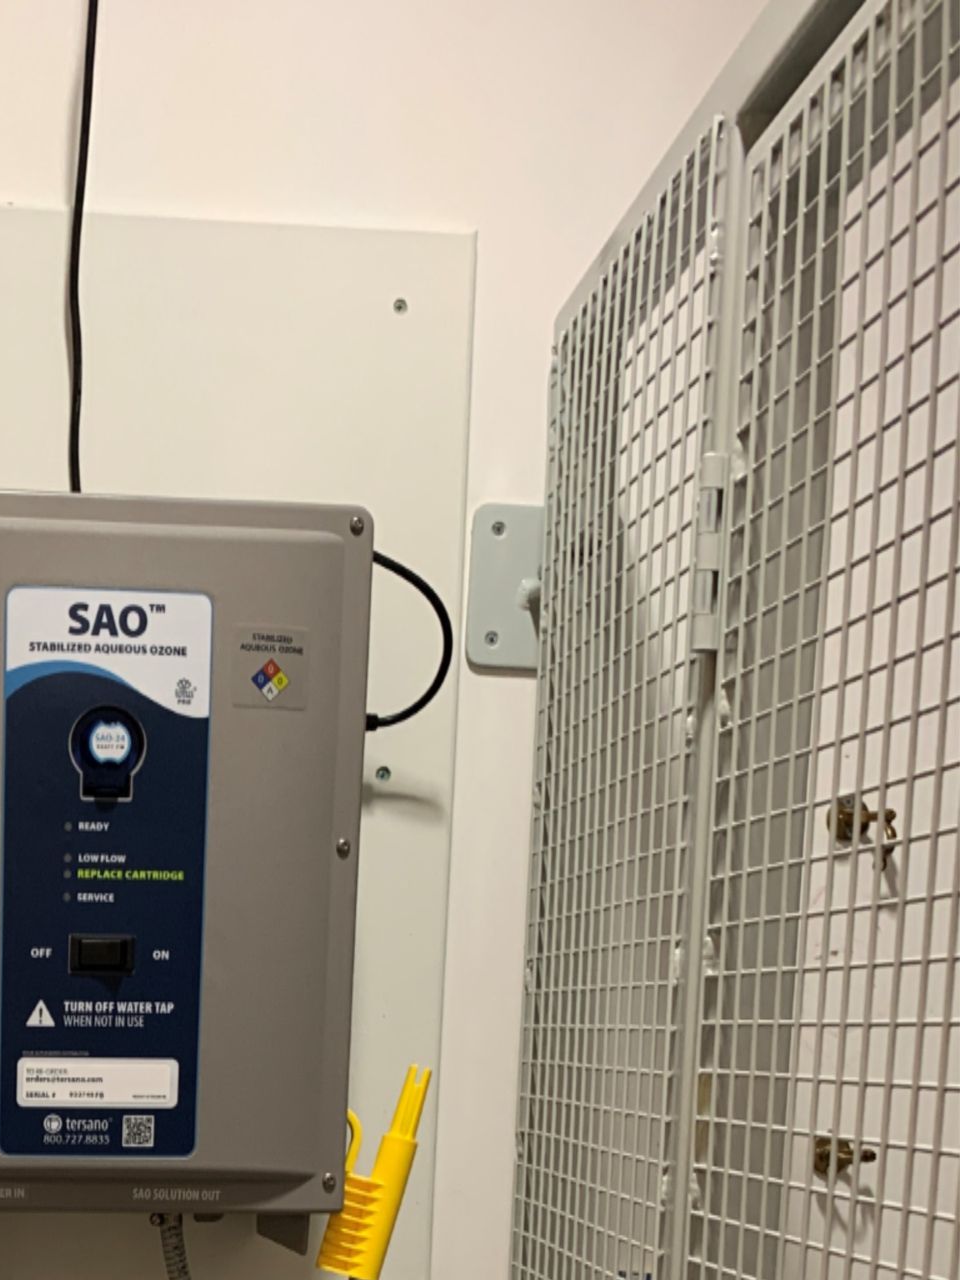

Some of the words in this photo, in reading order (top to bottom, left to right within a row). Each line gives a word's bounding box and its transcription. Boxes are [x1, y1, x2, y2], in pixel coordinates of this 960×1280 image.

[29, 642, 91, 652] STABILIZED
[95, 643, 147, 655] AQUEOUS
[150, 646, 187, 656] OZONE
[240, 643, 276, 652] AQUEOUS
[78, 822, 109, 832] READY
[78, 854, 99, 863] LOW
[100, 854, 126, 864] FLOW
[77, 869, 123, 880] REPLACE
[125, 870, 185, 881] CARTRIDGE
[77, 893, 115, 903] SERVICE
[30, 948, 52, 959] OFF
[152, 950, 170, 961] ON
[64, 1001, 93, 1013] TURN
[95, 1001, 115, 1013] OFF
[116, 1002, 153, 1014] WATER
[154, 1002, 175, 1014] TAP
[63, 1015, 93, 1027] WHEN
[94, 1015, 113, 1027] NOT
[115, 1015, 125, 1027] IN
[126, 1015, 144, 1027] USE
[26, 1076, 103, 1084] orders@tersano.com
[65, 1117, 109, 1132] tersano
[43, 1134, 110, 1145] 800.727.8835
[14, 1188, 25, 1198] IN
[132, 1188, 151, 1199] SAO
[153, 1189, 200, 1200] SOLUTION
[201, 1190, 221, 1200] OUT
